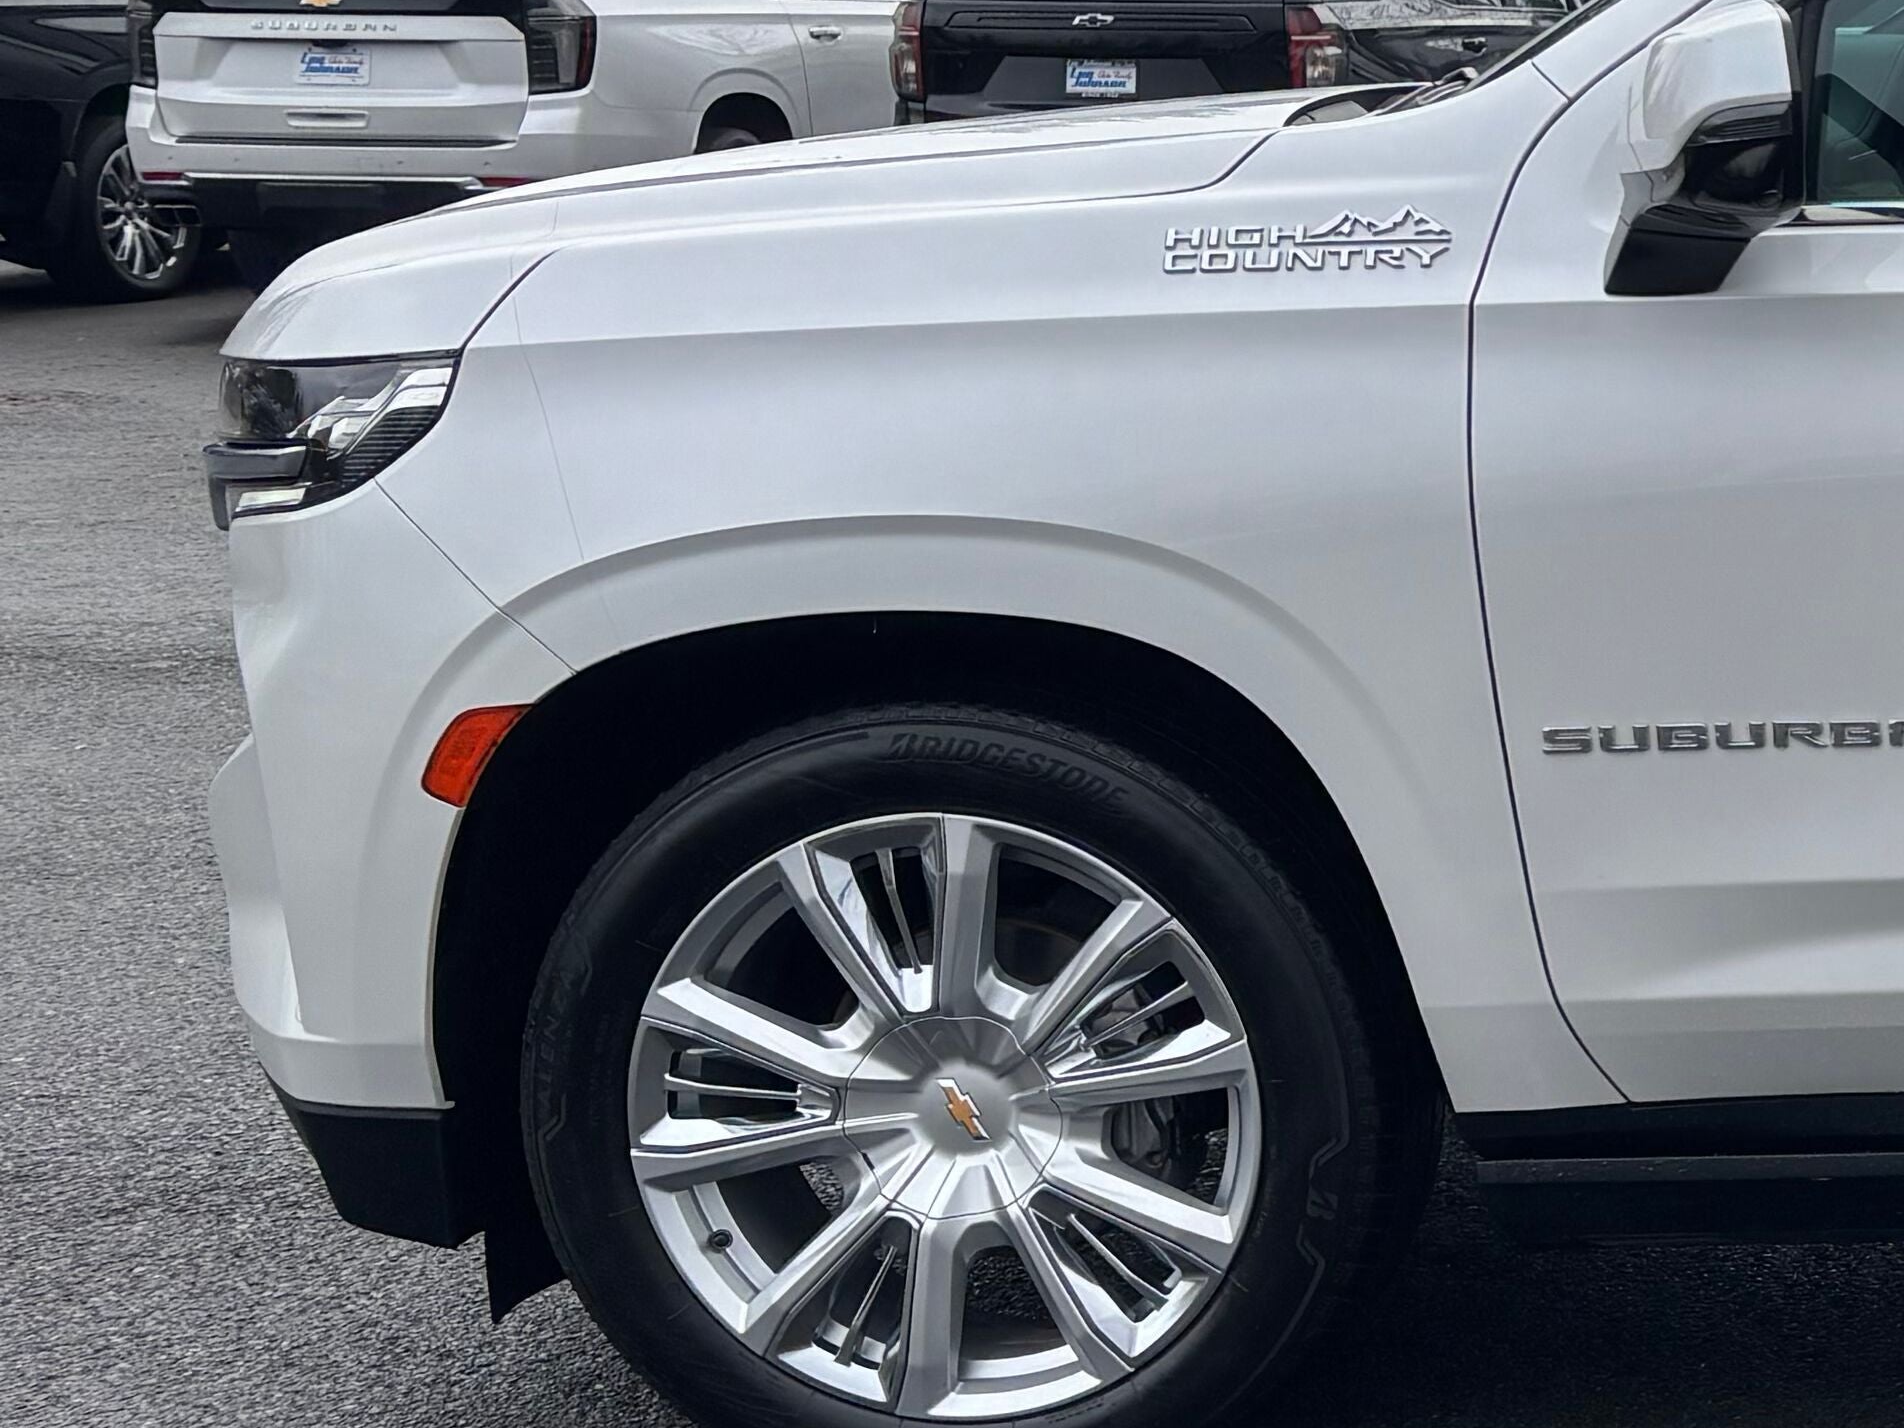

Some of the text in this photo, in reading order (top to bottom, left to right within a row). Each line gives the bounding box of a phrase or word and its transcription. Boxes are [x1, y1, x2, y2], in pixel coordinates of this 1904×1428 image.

[251, 21, 398, 33] SUBURBAN
[1164, 224, 1307, 250] HIGH
[1162, 245, 1451, 275] COUNTRY
[885, 732, 1131, 806] BRIDGESTONE
